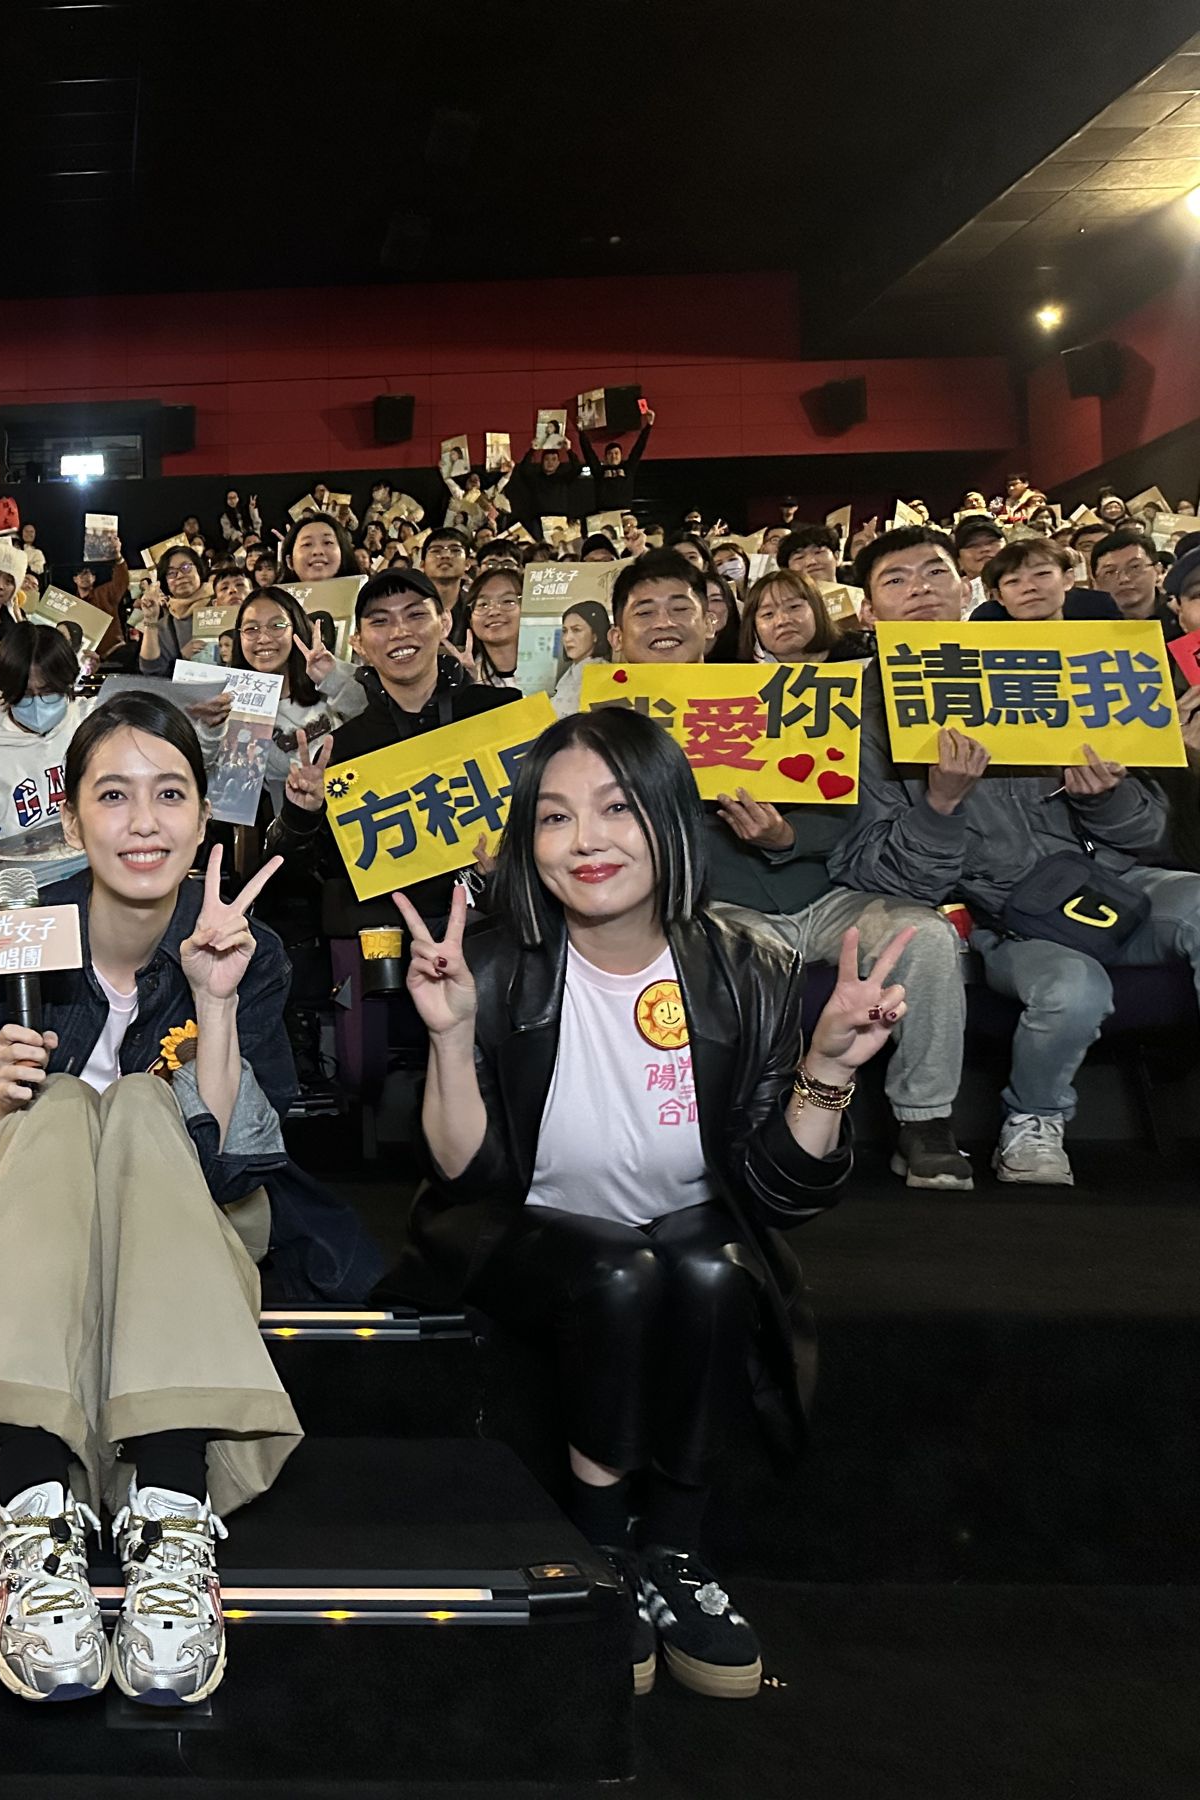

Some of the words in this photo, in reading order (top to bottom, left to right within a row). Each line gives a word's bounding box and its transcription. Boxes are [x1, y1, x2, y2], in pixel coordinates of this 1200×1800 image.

[225, 672, 279, 693] 陽光女子
[886, 643, 1172, 729] 請罵我
[13, 765, 66, 827] GA
